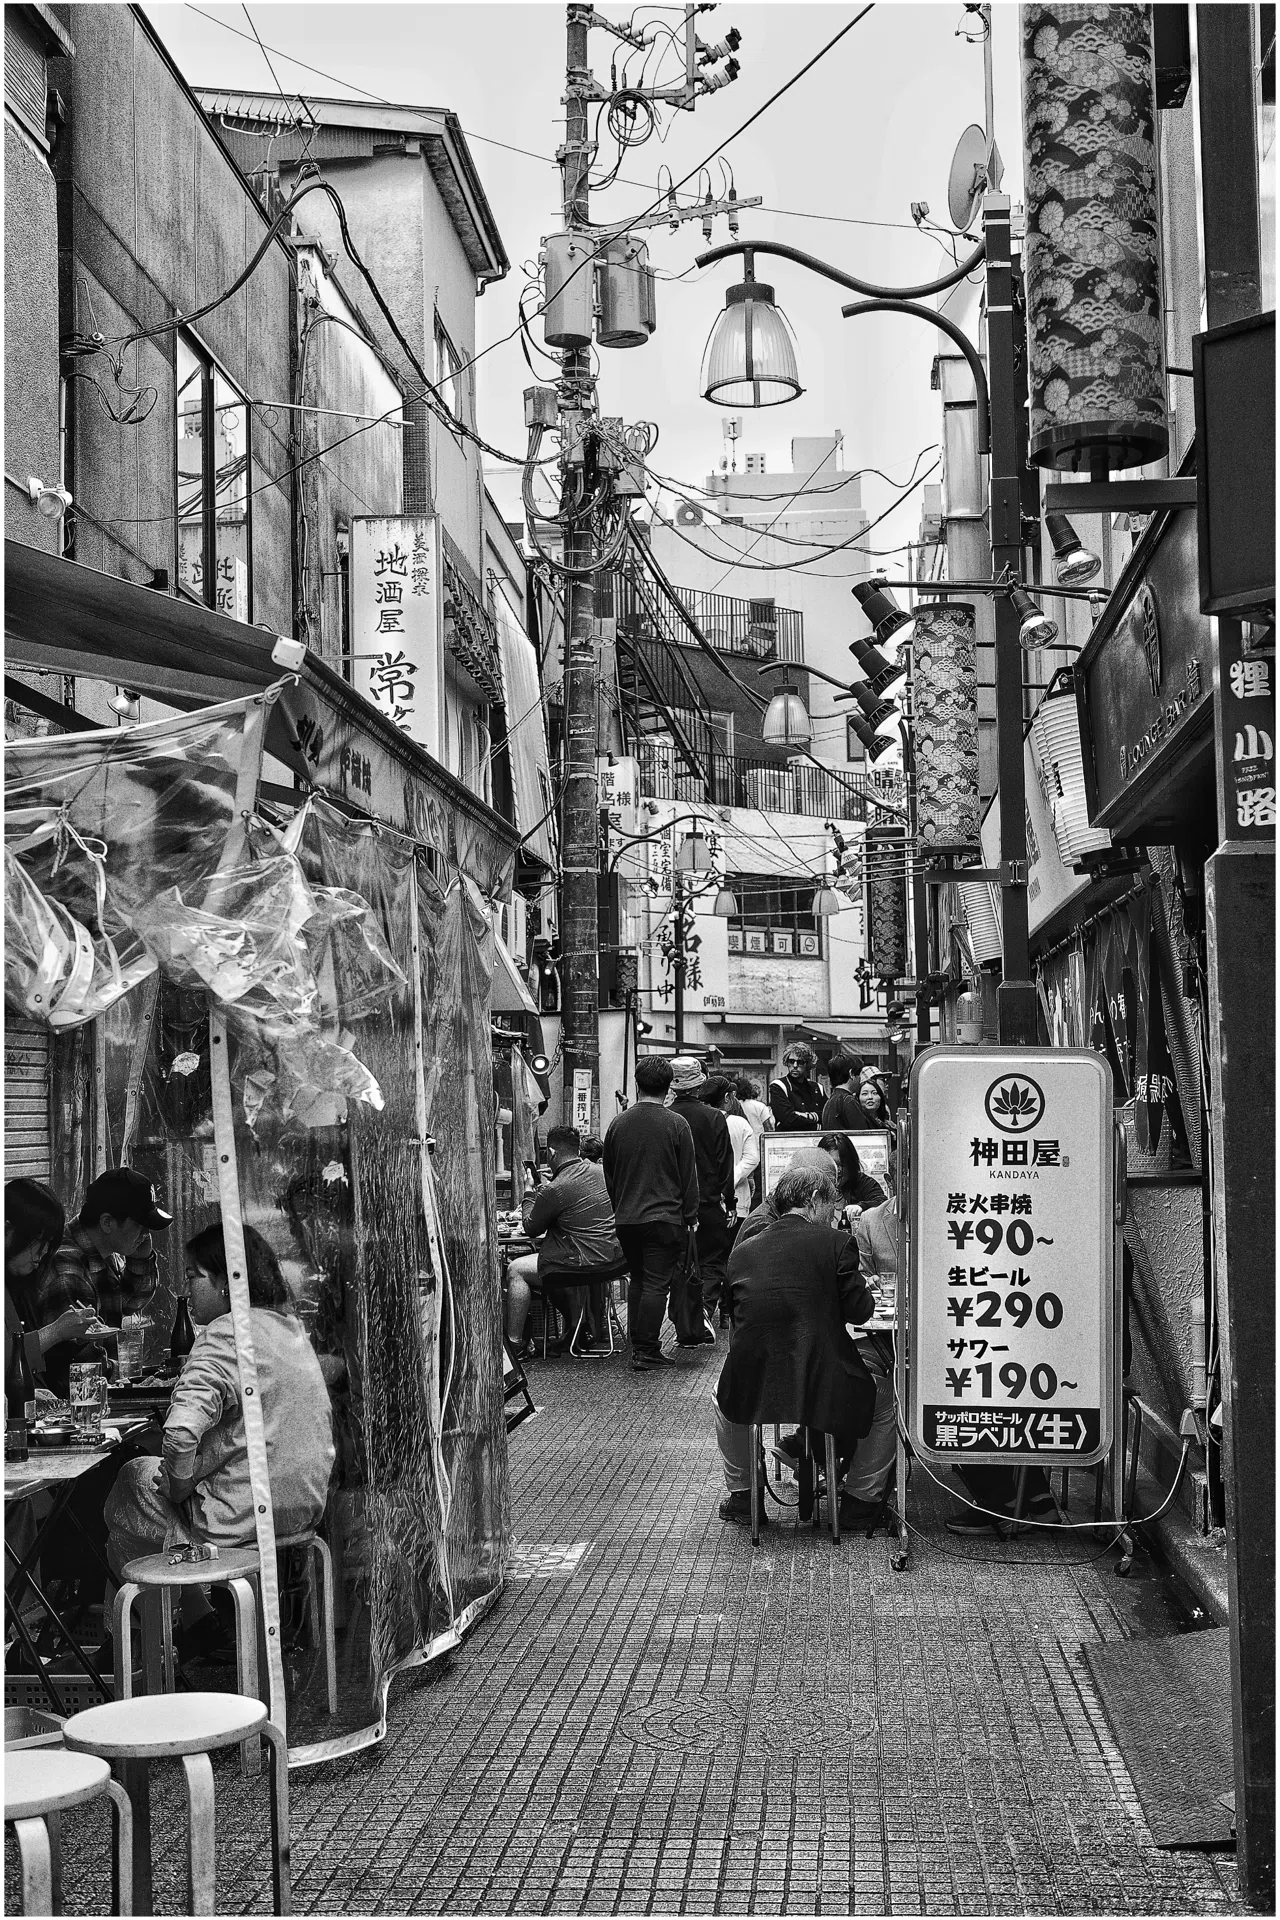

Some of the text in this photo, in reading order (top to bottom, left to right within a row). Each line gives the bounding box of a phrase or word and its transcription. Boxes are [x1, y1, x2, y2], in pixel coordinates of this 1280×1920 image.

[373, 544, 408, 633] 地酒屋
[1165, 689, 1188, 729] BAR
[968, 1137, 1061, 1168] 神田屋
[989, 1170, 1040, 1180] KANDAYA
[946, 1192, 1033, 1215] 炭火串焼
[947, 1265, 1031, 1287] 生ビール
[946, 1290, 1065, 1330] ¥290
[946, 1337, 1010, 1360] サワー
[934, 1410, 1023, 1426] サッポロ生ビール
[934, 1424, 1023, 1449] 黒ラベル
